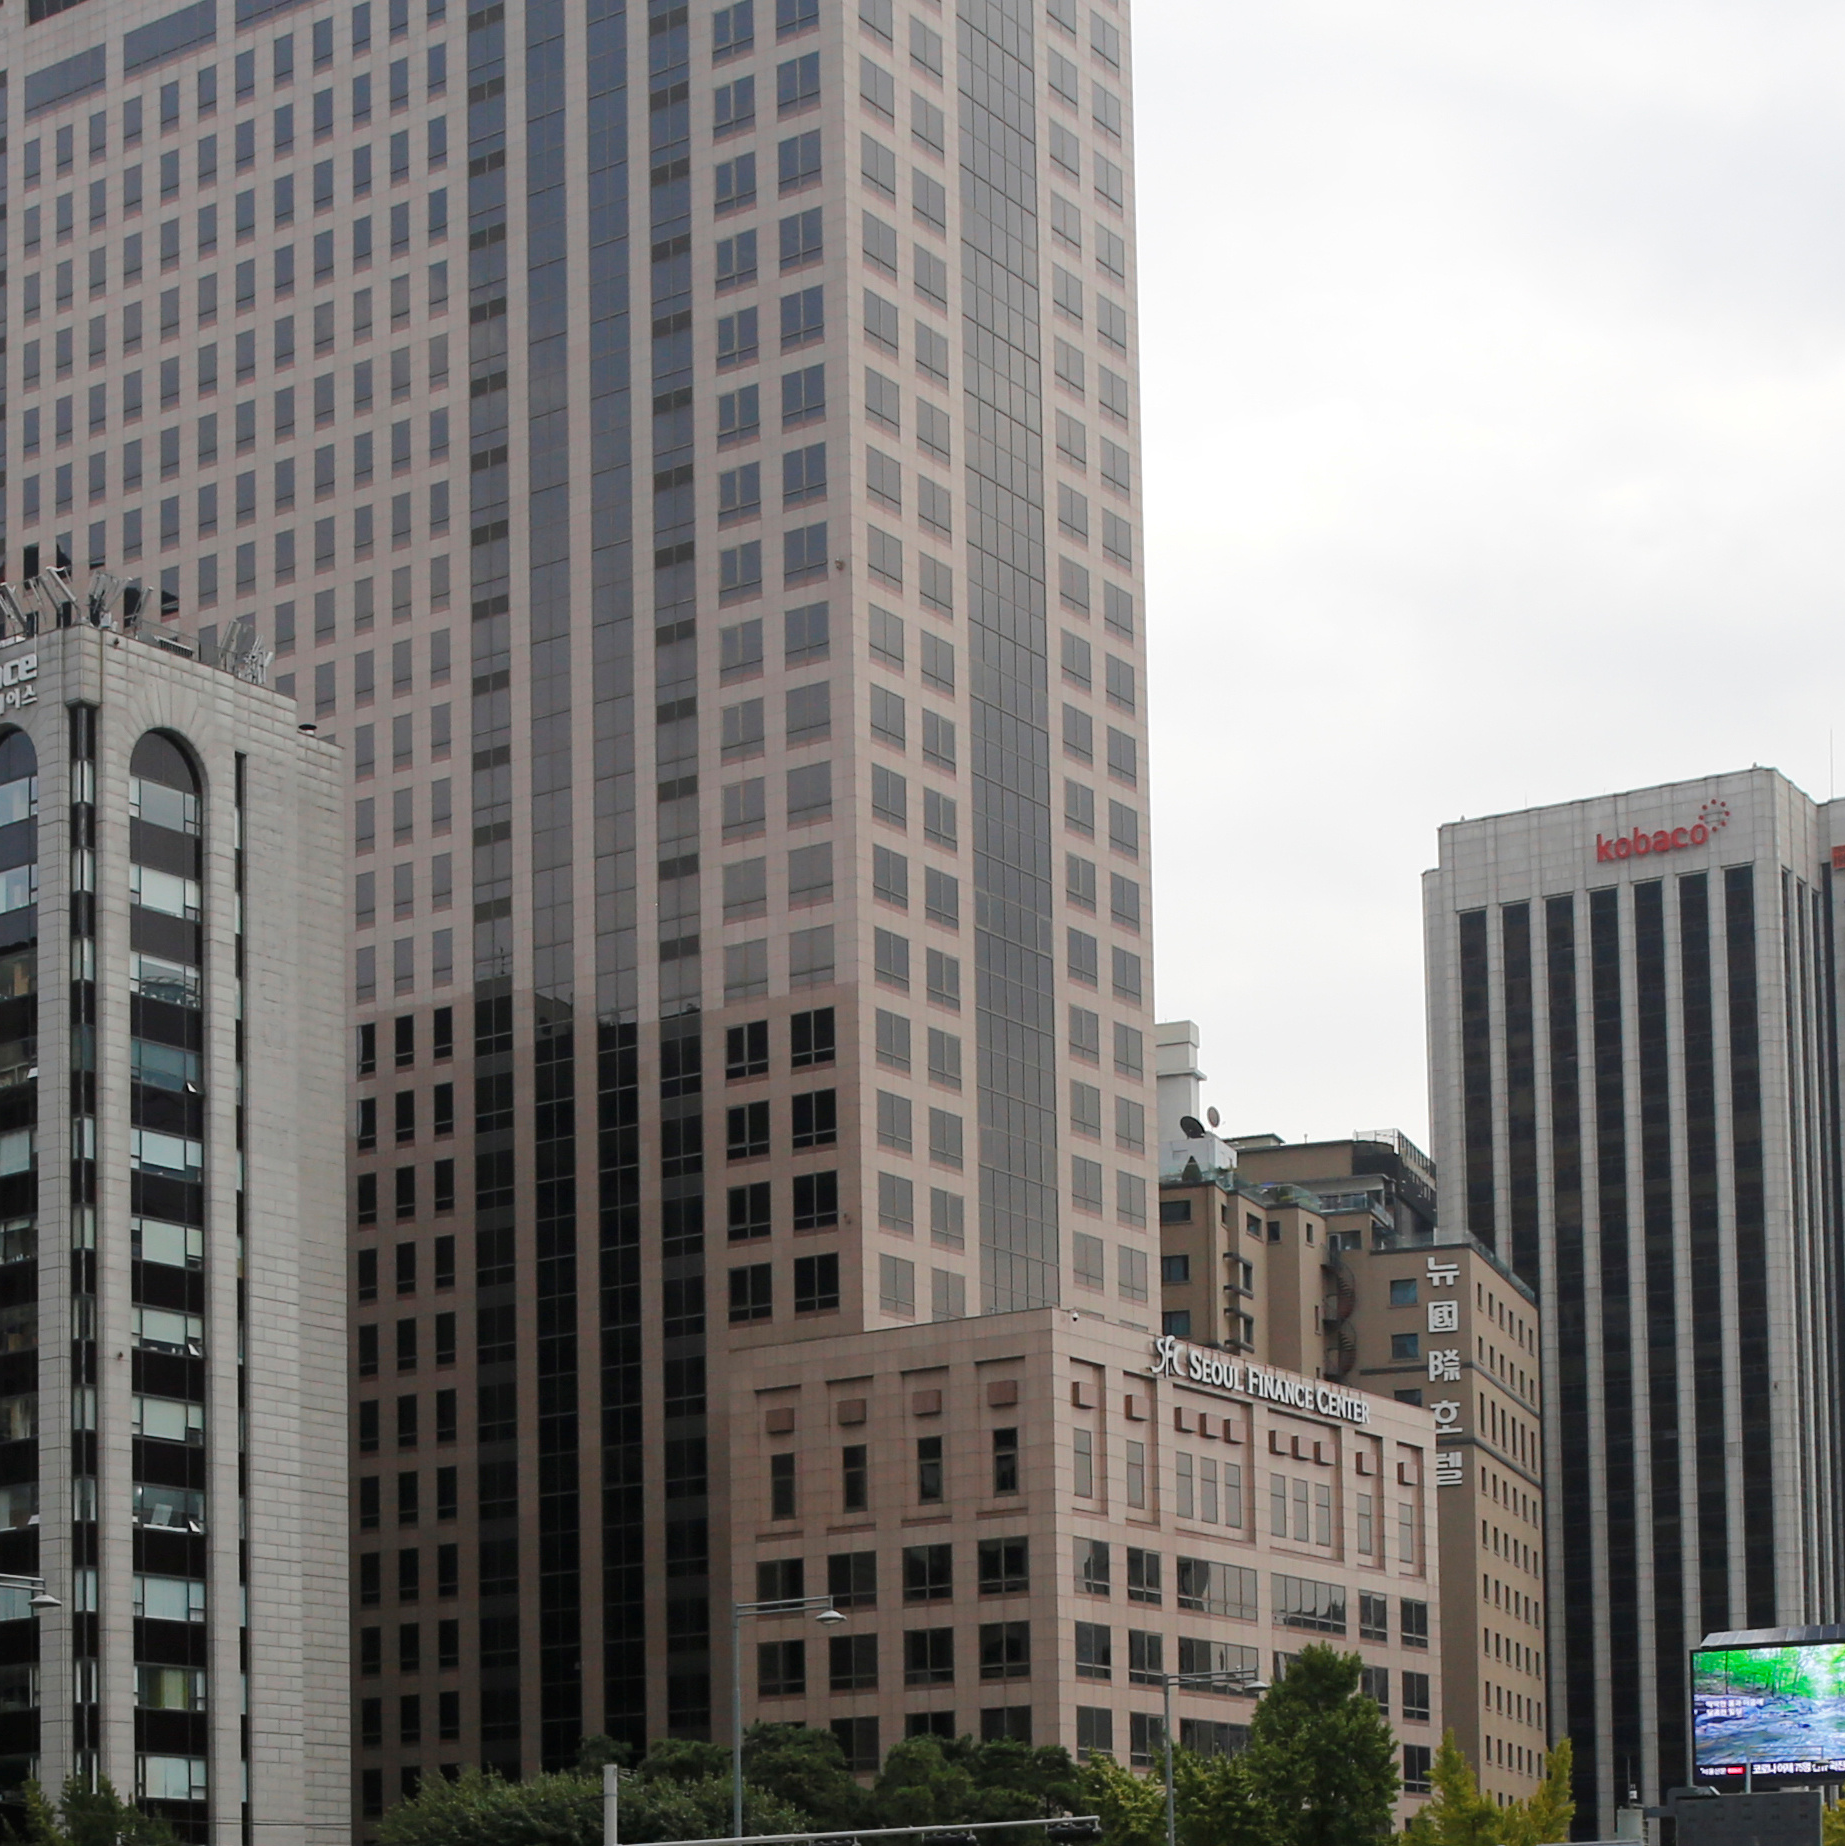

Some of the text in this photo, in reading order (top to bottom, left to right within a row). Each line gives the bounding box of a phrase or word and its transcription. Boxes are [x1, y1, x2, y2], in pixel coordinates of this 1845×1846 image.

[1596, 823, 1709, 863] kobaco
[1188, 1350, 1245, 1392] SEOUL
[1246, 1365, 1314, 1411] FINANCE
[1315, 1386, 1370, 1424] CENTER
